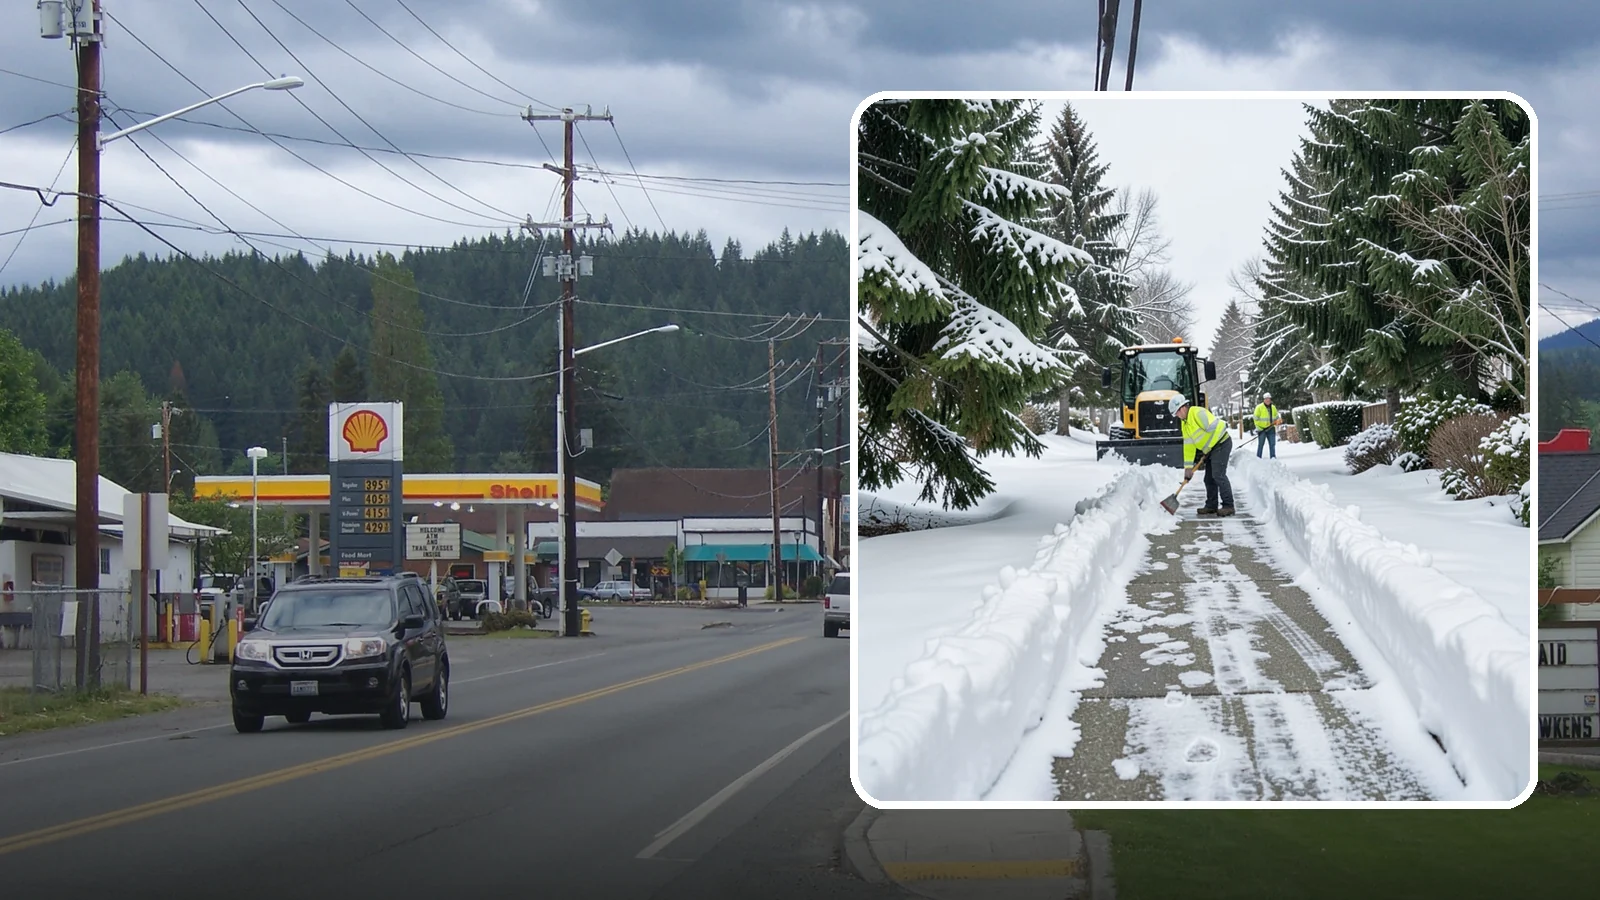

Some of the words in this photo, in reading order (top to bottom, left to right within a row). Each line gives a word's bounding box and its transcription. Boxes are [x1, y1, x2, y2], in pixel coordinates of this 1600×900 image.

[365, 480, 383, 490] 395
[490, 484, 547, 499] Shell
[365, 494, 383, 504] 405
[365, 508, 383, 518] 415
[365, 522, 383, 532] 429
